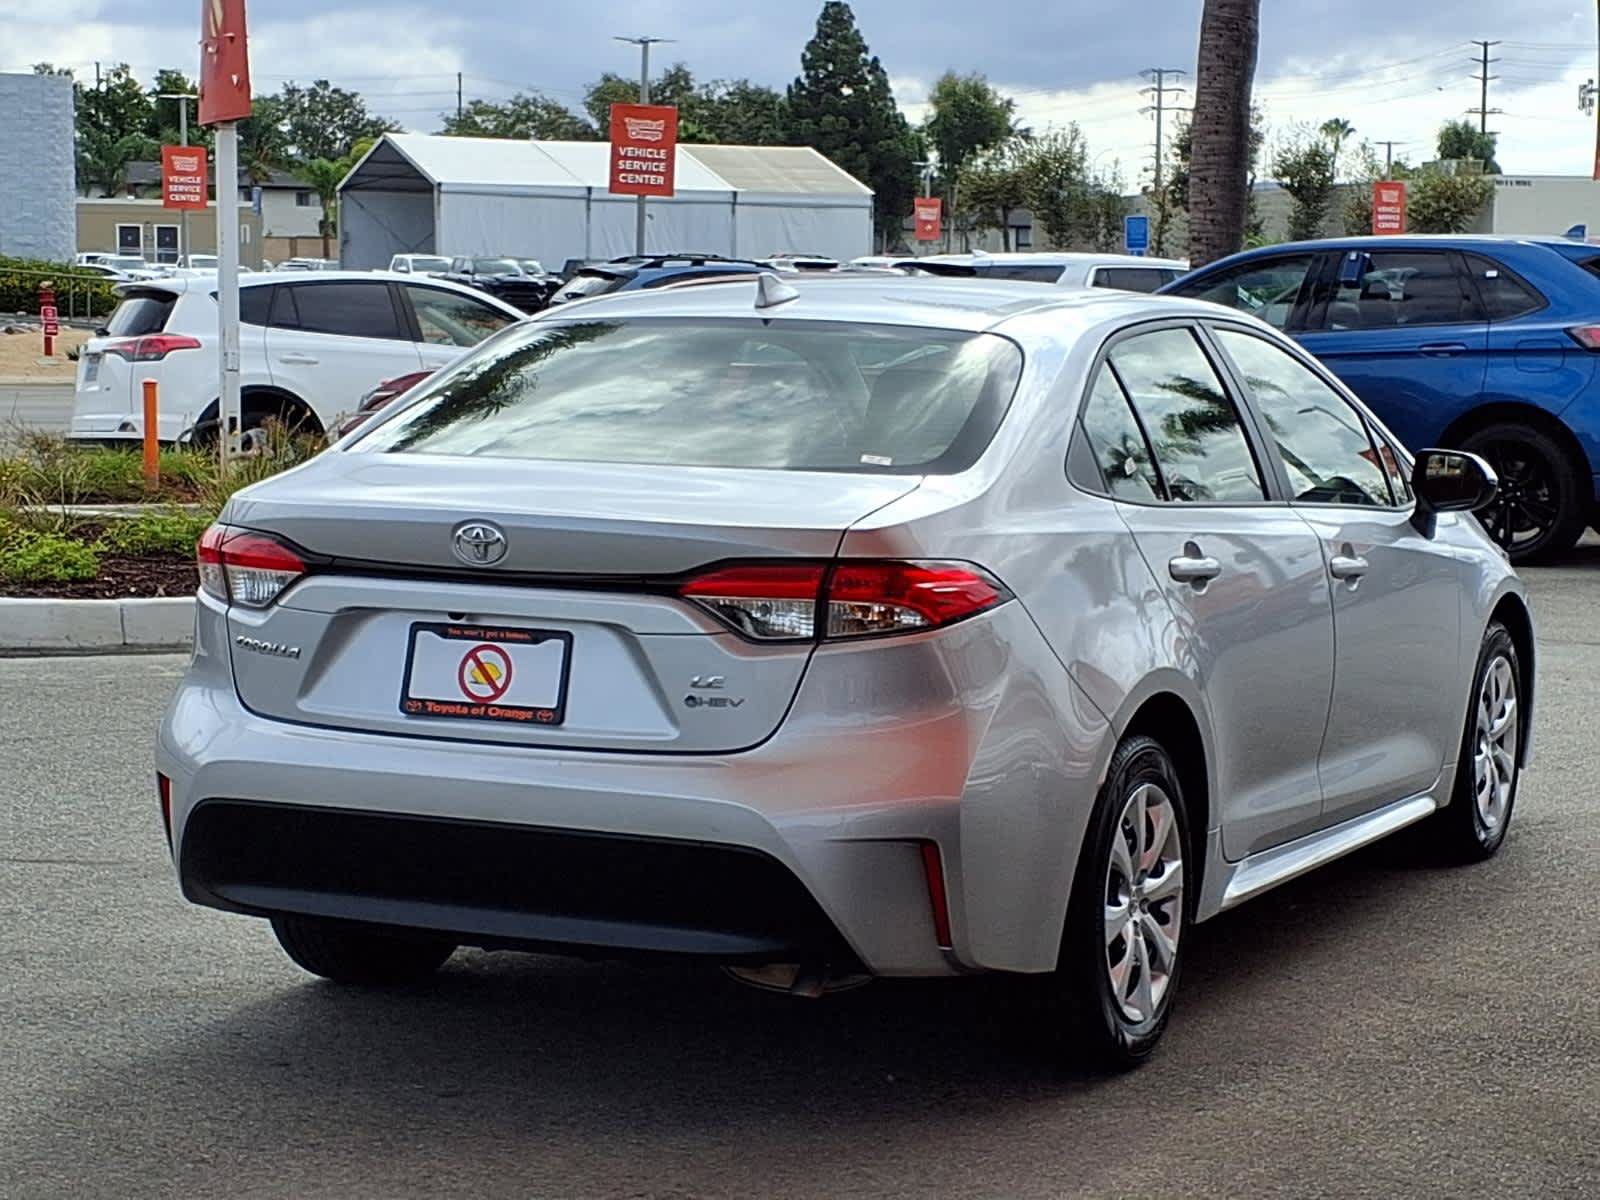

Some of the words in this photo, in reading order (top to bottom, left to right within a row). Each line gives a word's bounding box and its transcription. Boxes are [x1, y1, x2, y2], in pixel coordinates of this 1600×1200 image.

[618, 146, 668, 159] VEHICLE
[618, 160, 667, 172] SERVICE
[168, 176, 201, 184] VEHICLE
[618, 173, 665, 185] CENTER
[168, 185, 201, 193] SERVICE
[169, 193, 201, 202] CENTER
[236, 635, 302, 660] COROLLA
[690, 675, 725, 689] LE
[426, 702, 469, 717] Toyota
[470, 705, 485, 716] of
[487, 706, 534, 720] Orange
